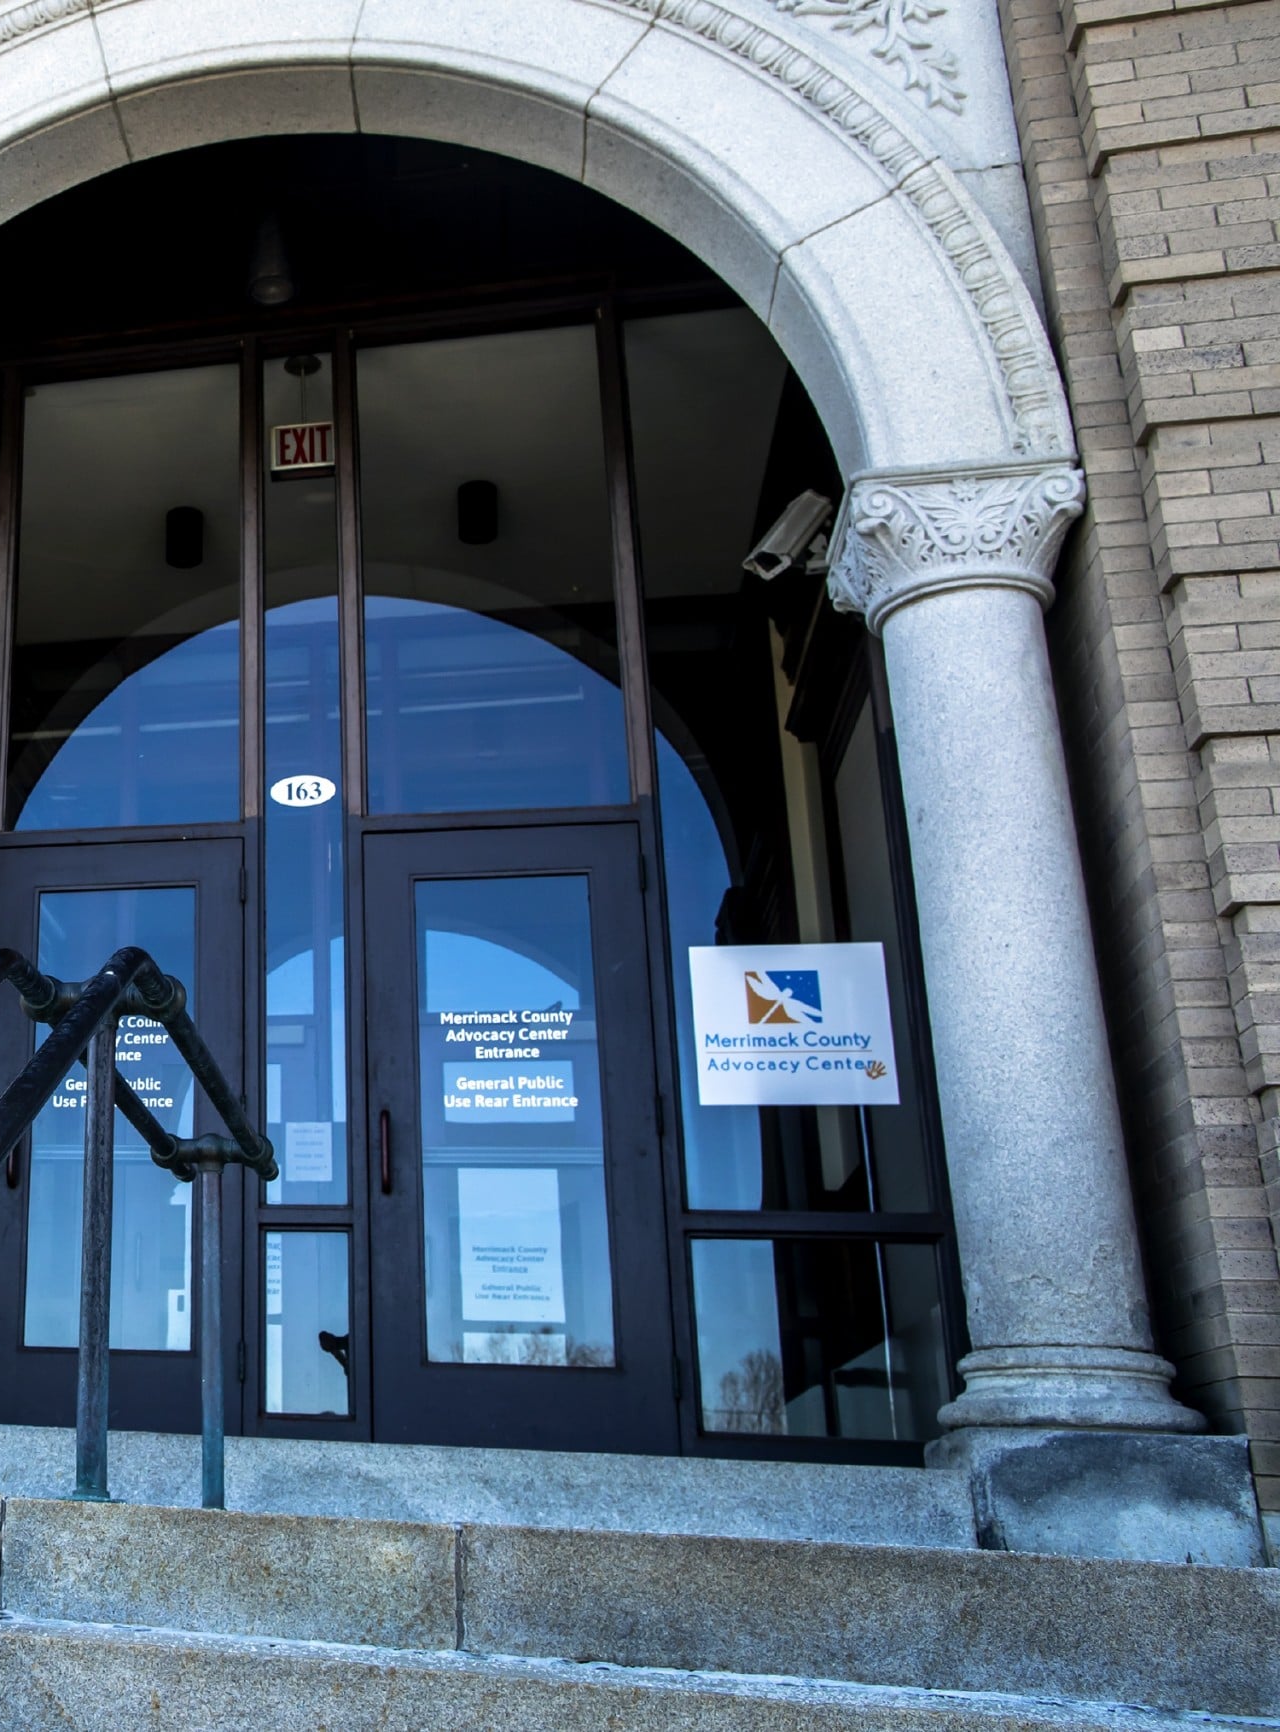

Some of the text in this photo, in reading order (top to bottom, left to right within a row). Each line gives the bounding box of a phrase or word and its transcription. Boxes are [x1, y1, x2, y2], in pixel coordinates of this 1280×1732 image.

[280, 425, 331, 464] EXIT
[287, 782, 322, 800] 163
[127, 1016, 161, 1028] Coun
[440, 1010, 573, 1025] Merrimack County
[124, 1033, 169, 1044] Center
[445, 1028, 569, 1043] Advocacy Center
[705, 1031, 871, 1049] Merrimack County
[475, 1046, 540, 1059] Entrance
[707, 1056, 875, 1073] Advocacy Center
[127, 1078, 161, 1090] ublic
[456, 1076, 564, 1090] General Public
[53, 1096, 77, 1107] Use
[444, 1094, 579, 1108] Use Rear Entrance
